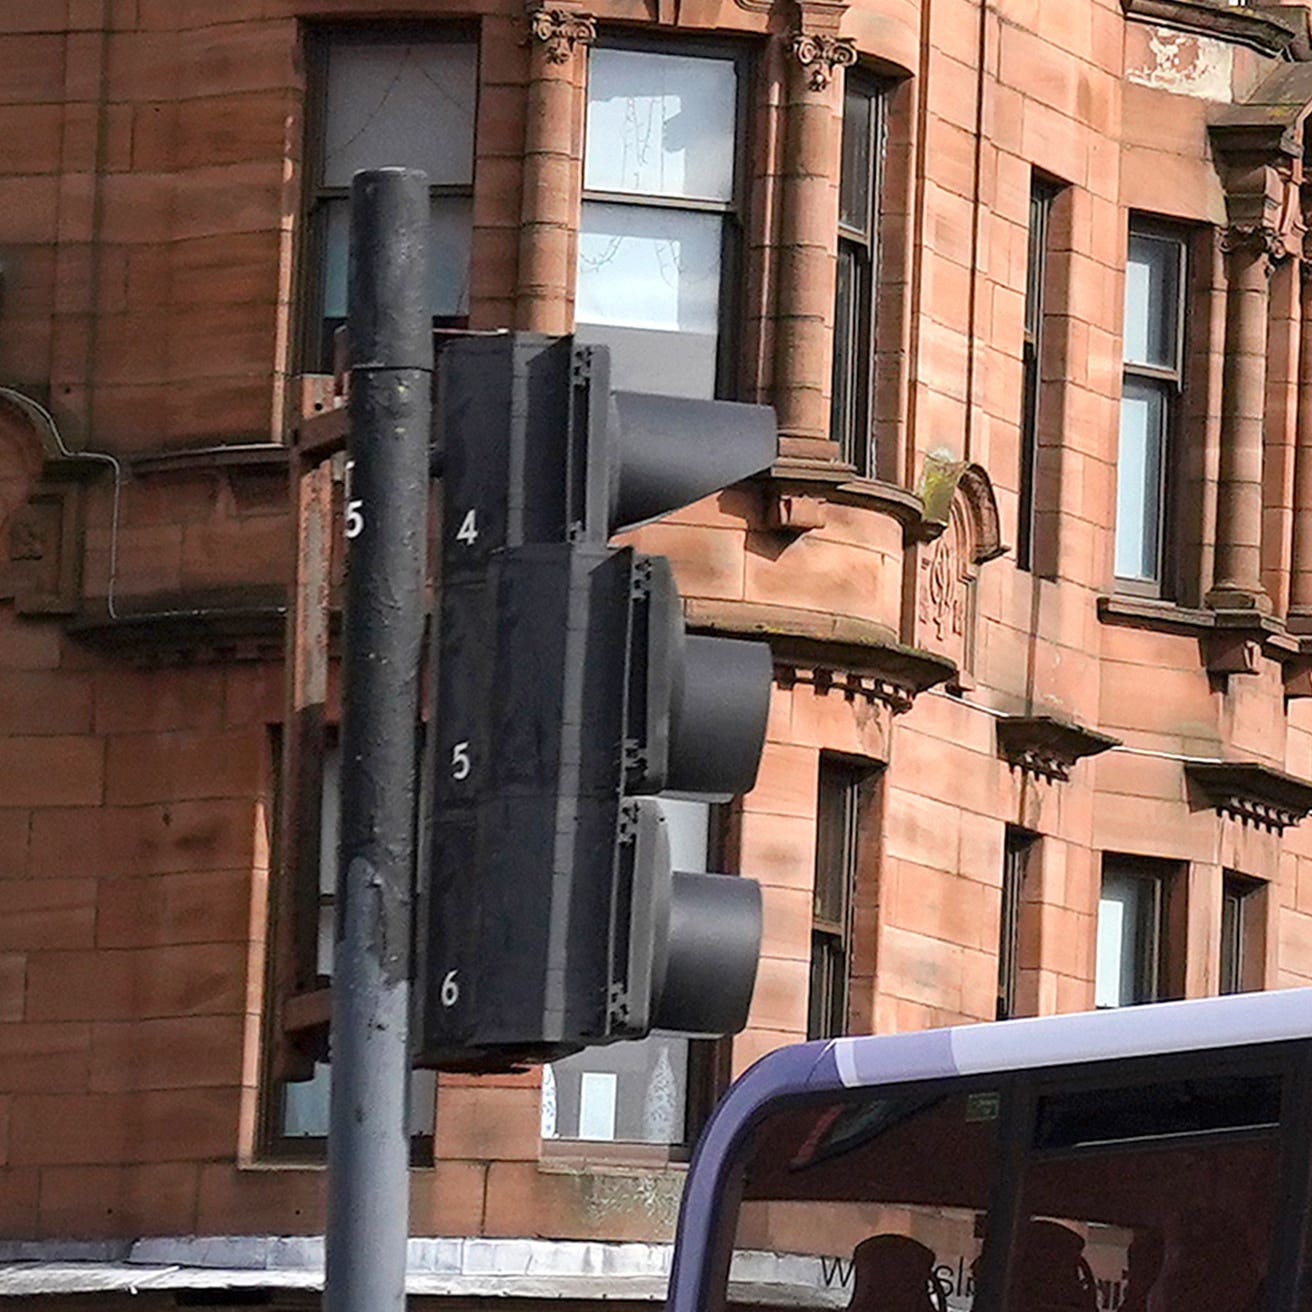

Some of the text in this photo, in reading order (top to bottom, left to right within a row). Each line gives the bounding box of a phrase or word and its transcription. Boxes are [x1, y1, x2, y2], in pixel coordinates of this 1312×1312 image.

[344, 500, 364, 538] 5
[456, 510, 479, 545] 4
[453, 743, 472, 780] 5
[441, 972, 460, 1007] 6
